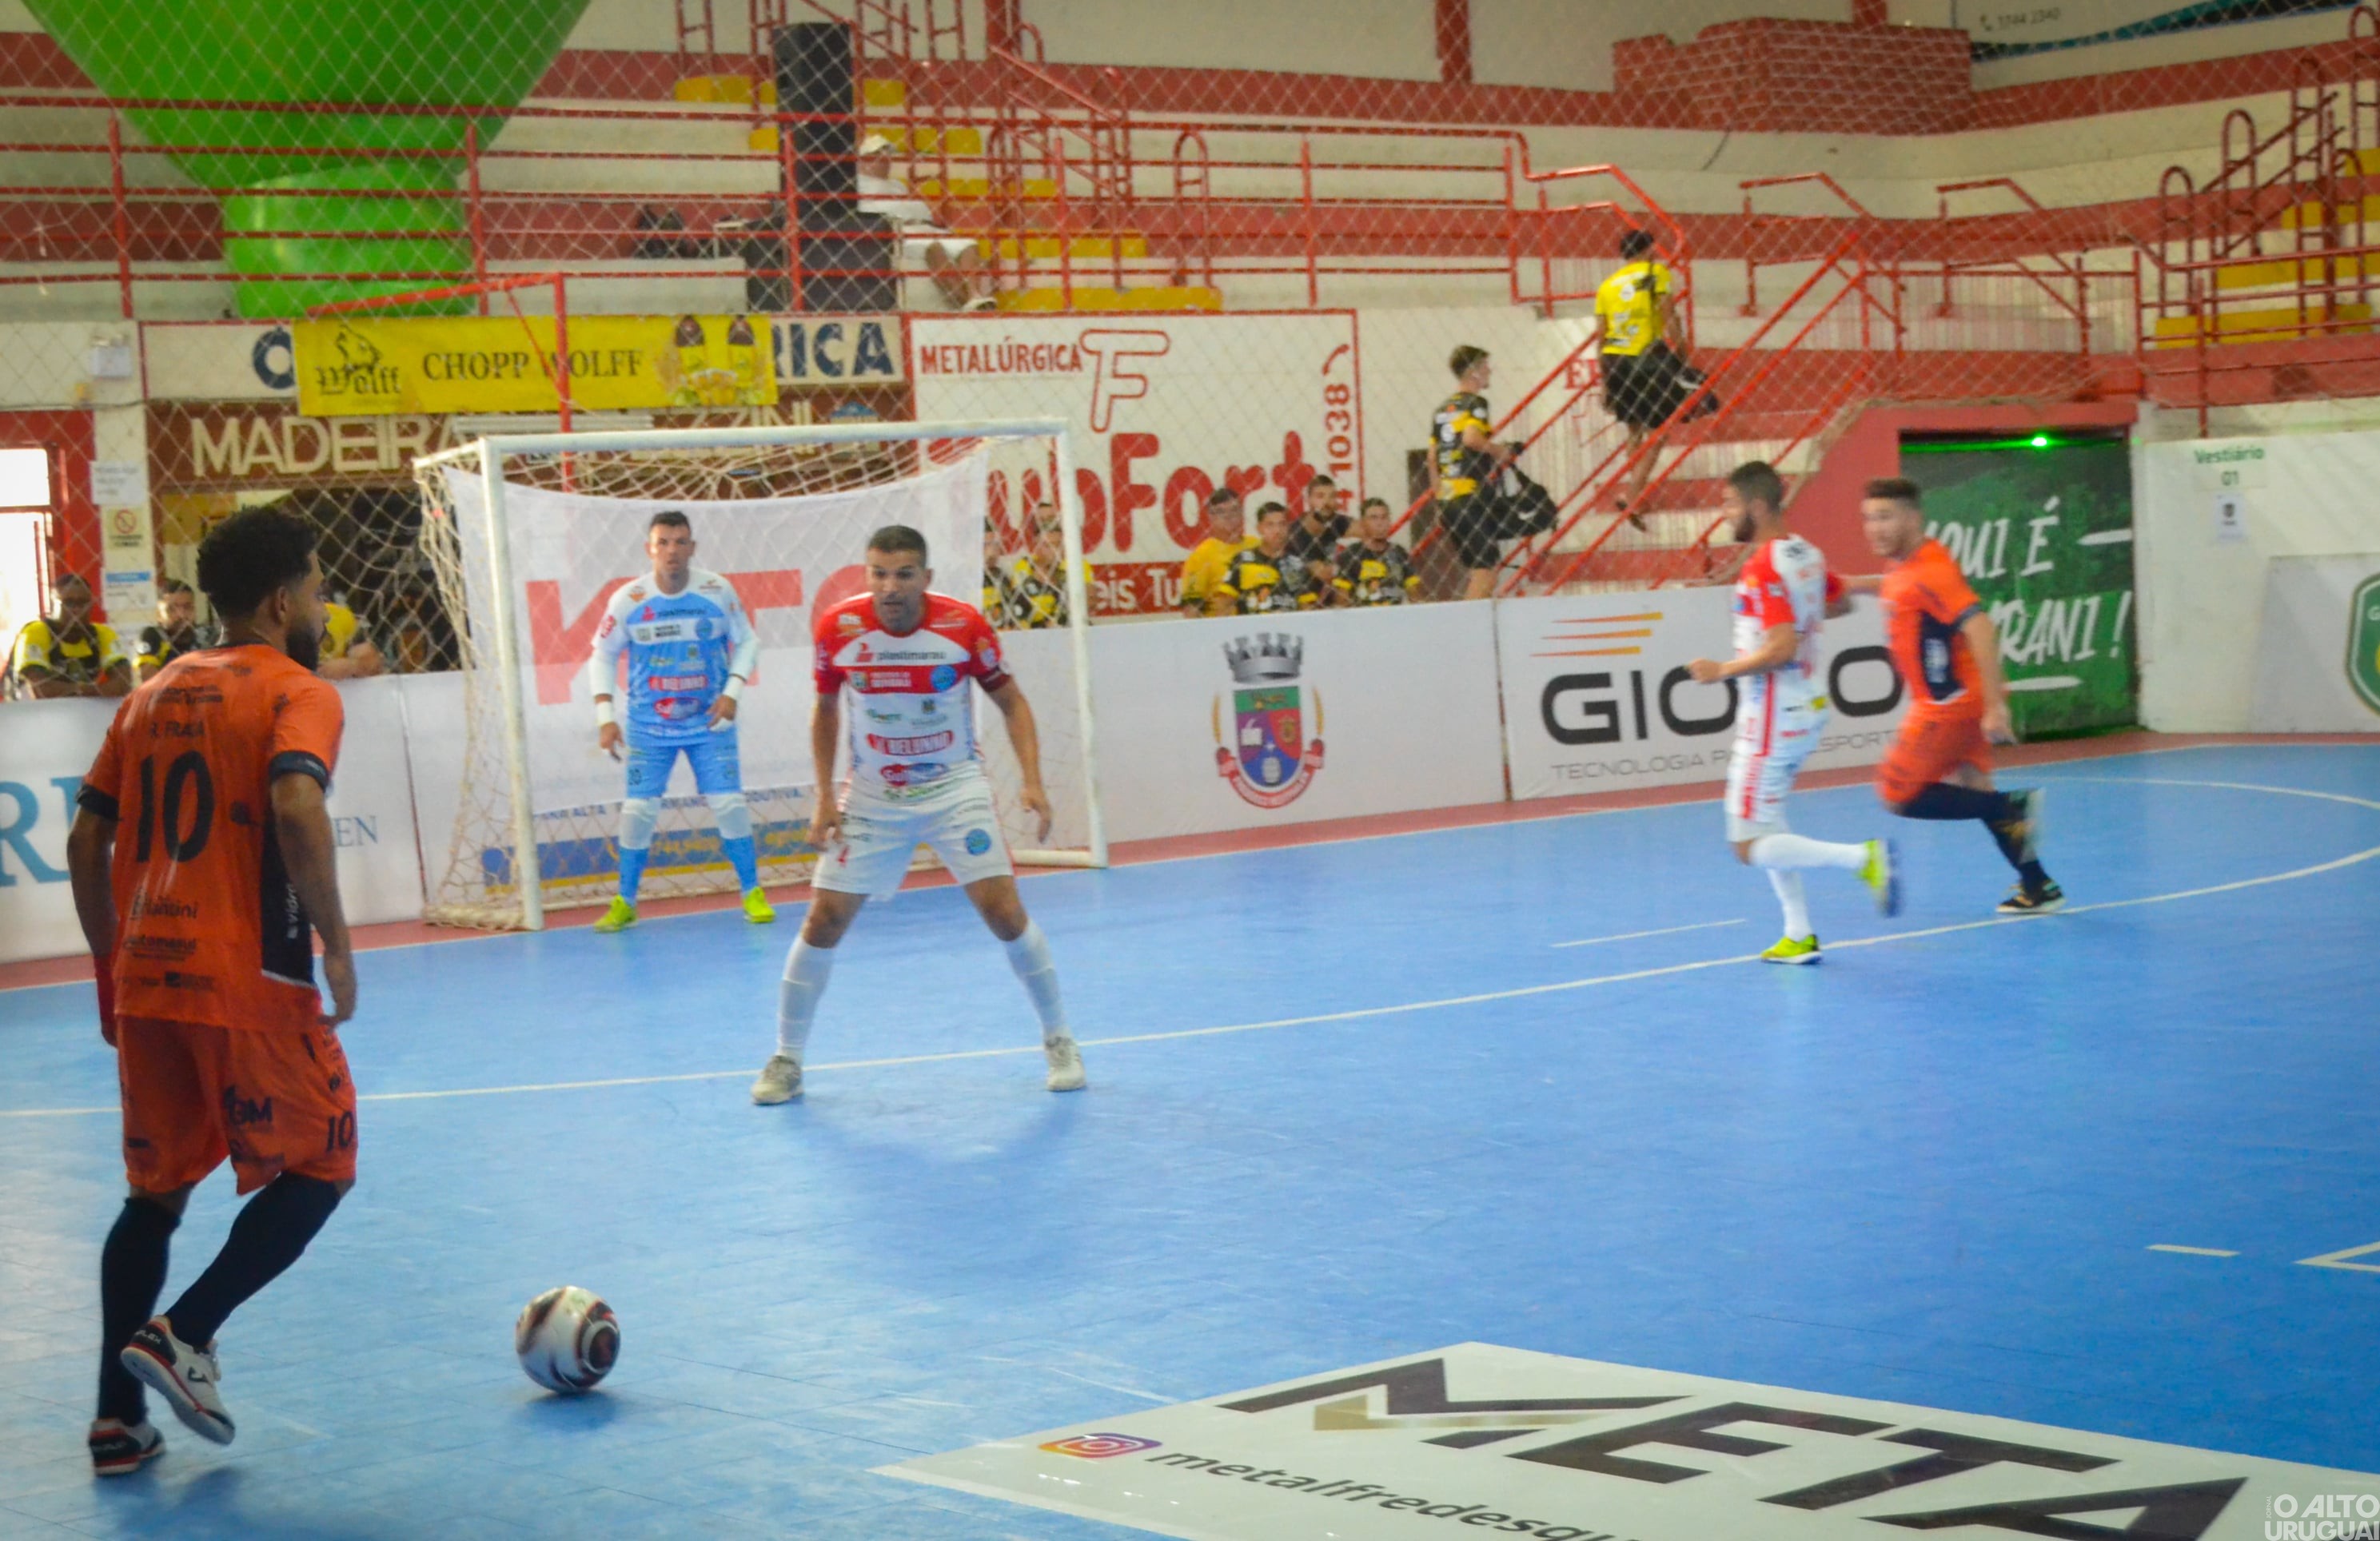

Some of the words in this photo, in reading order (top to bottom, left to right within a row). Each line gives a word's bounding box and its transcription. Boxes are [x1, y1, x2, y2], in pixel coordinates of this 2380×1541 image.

[423, 352, 529, 380] CHOPP
[920, 336, 1083, 374] METALÚRGICA
[1924, 519, 2011, 579] QUI
[1541, 645, 1908, 745] GIOO
[1551, 754, 1704, 781] TECNOLOGIA
[136, 750, 214, 863] 10
[326, 1111, 354, 1152] 10
[1214, 1357, 2250, 1541] META
